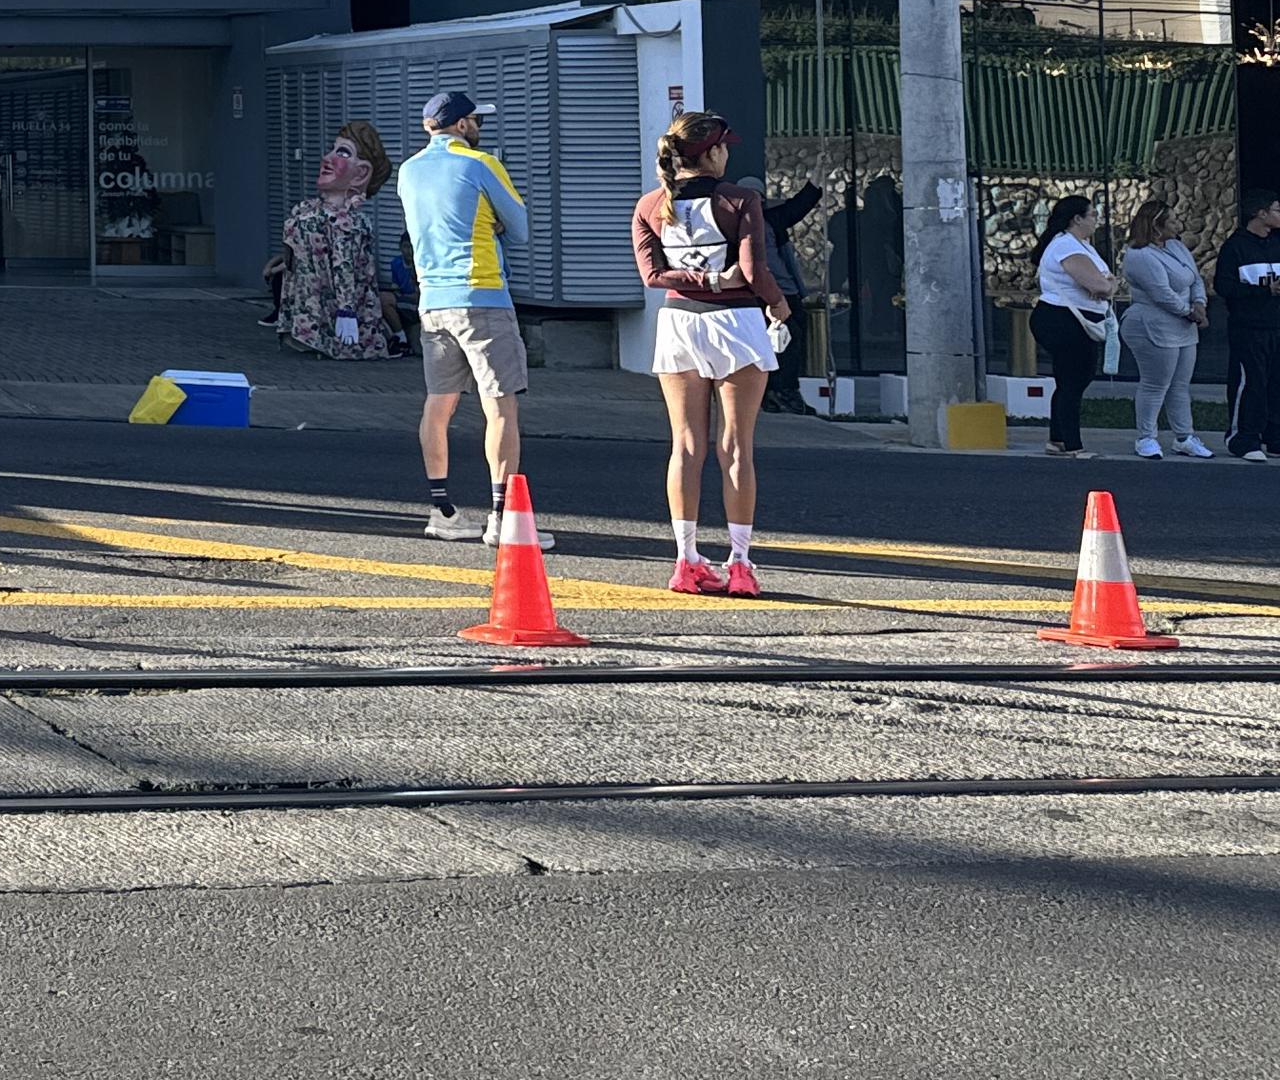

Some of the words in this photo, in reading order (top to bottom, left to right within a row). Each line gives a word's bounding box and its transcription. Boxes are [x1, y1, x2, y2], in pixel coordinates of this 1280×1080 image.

[98, 123, 134, 131] como
[118, 151, 131, 161] tu
[98, 166, 215, 190] columna
